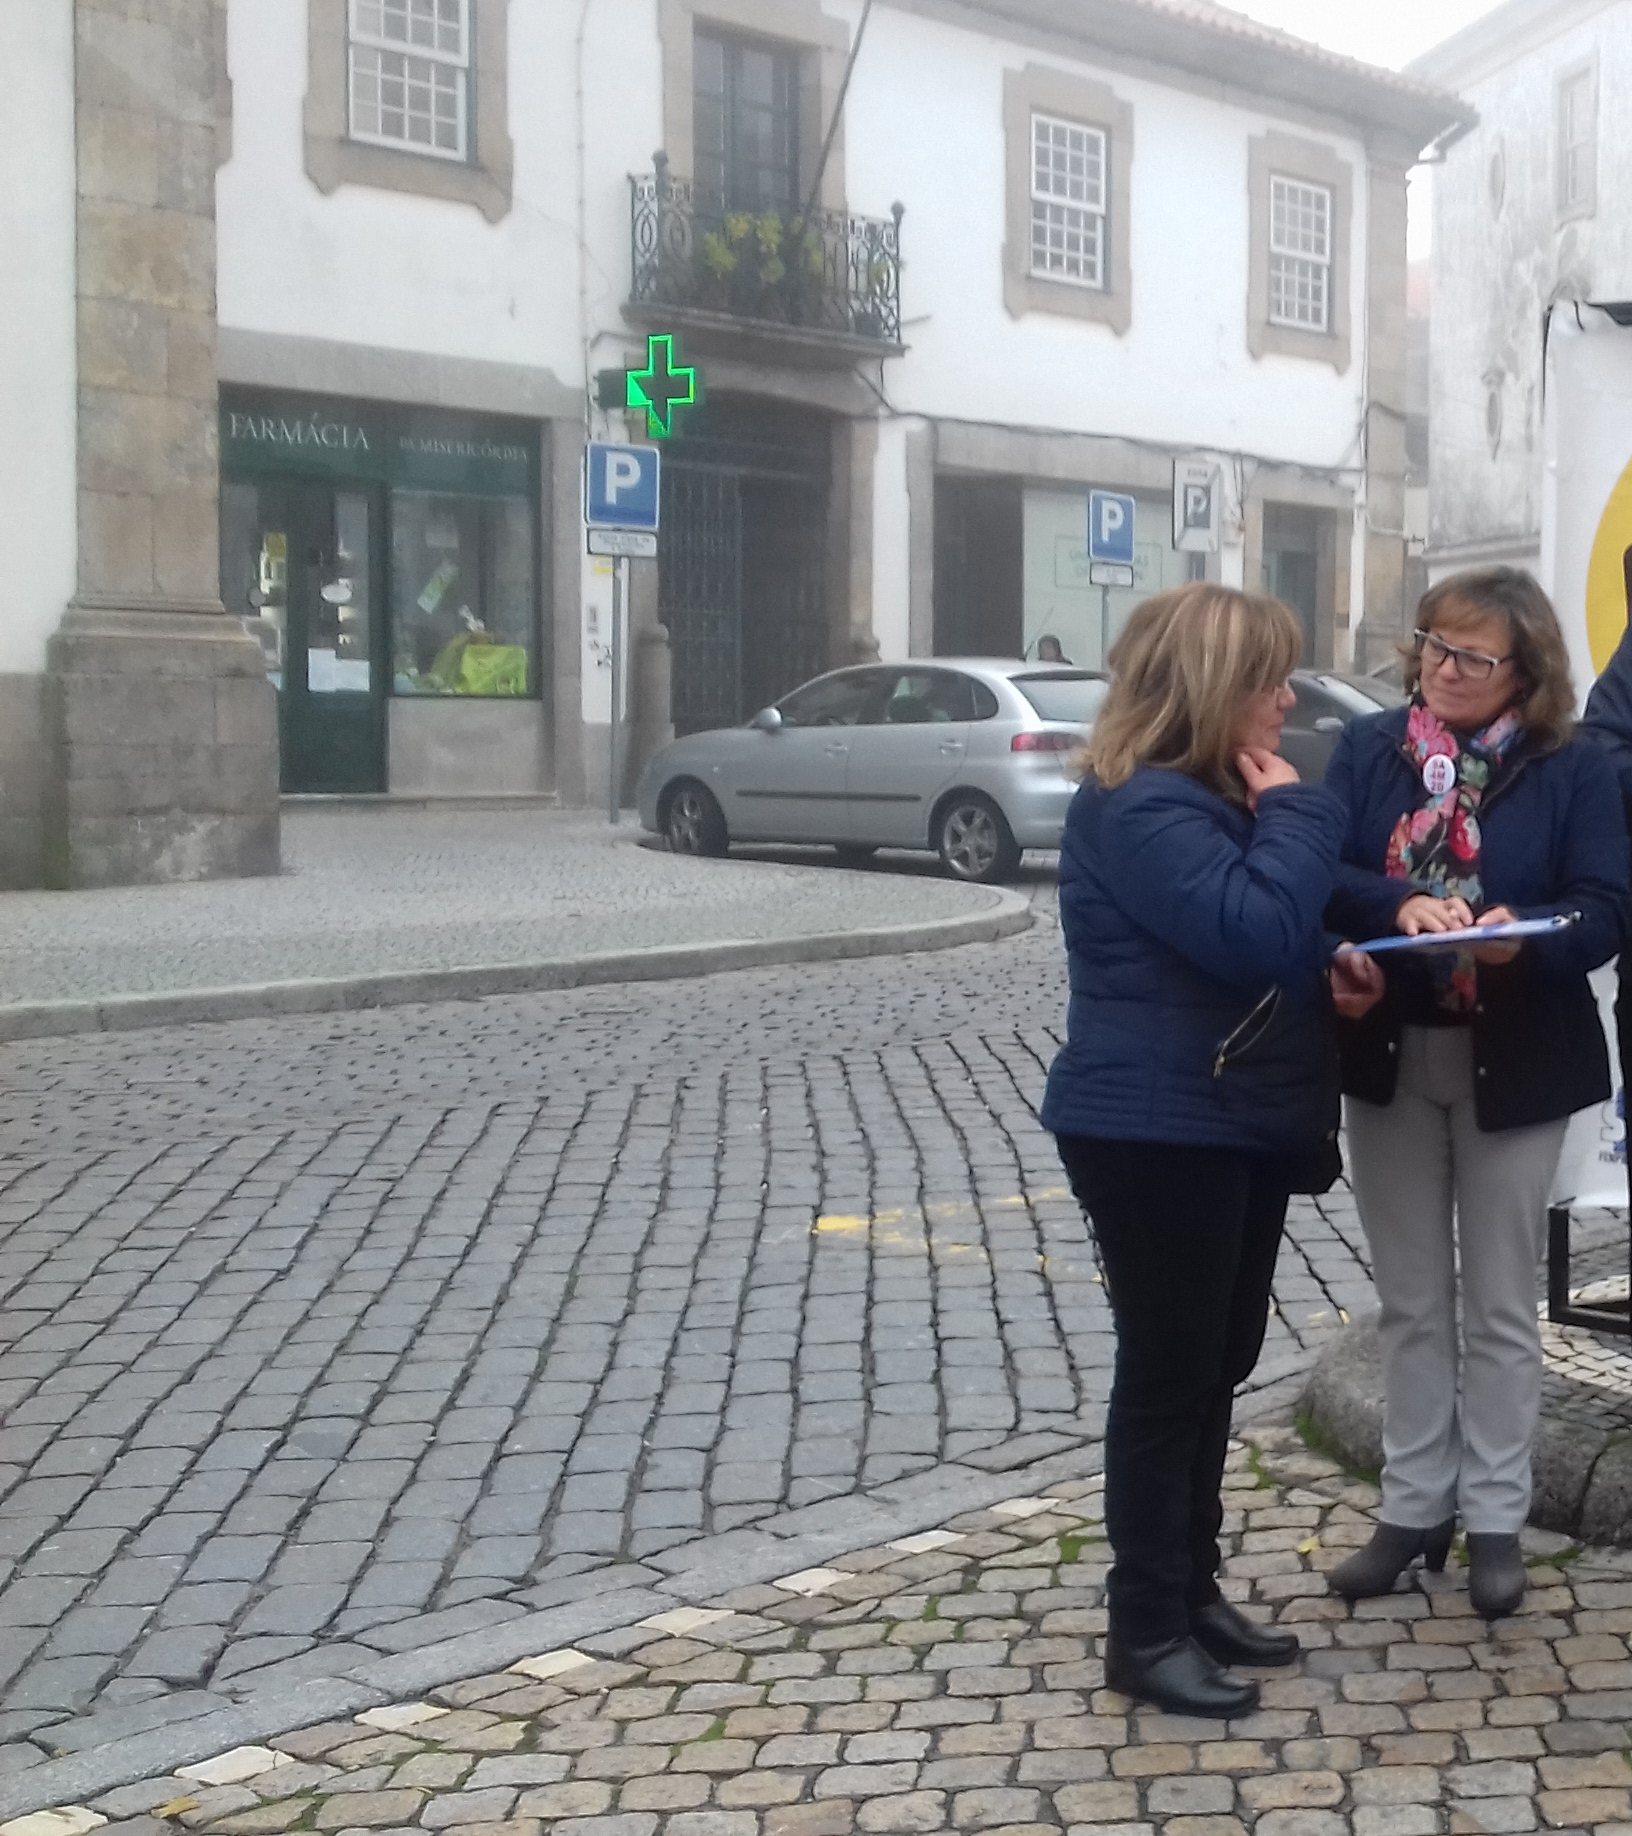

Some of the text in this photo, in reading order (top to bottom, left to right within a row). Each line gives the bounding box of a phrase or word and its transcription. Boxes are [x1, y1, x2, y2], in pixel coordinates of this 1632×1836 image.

[229, 411, 369, 450] FARMÁCIA
[606, 451, 641, 505] P
[1101, 499, 1124, 543] P
